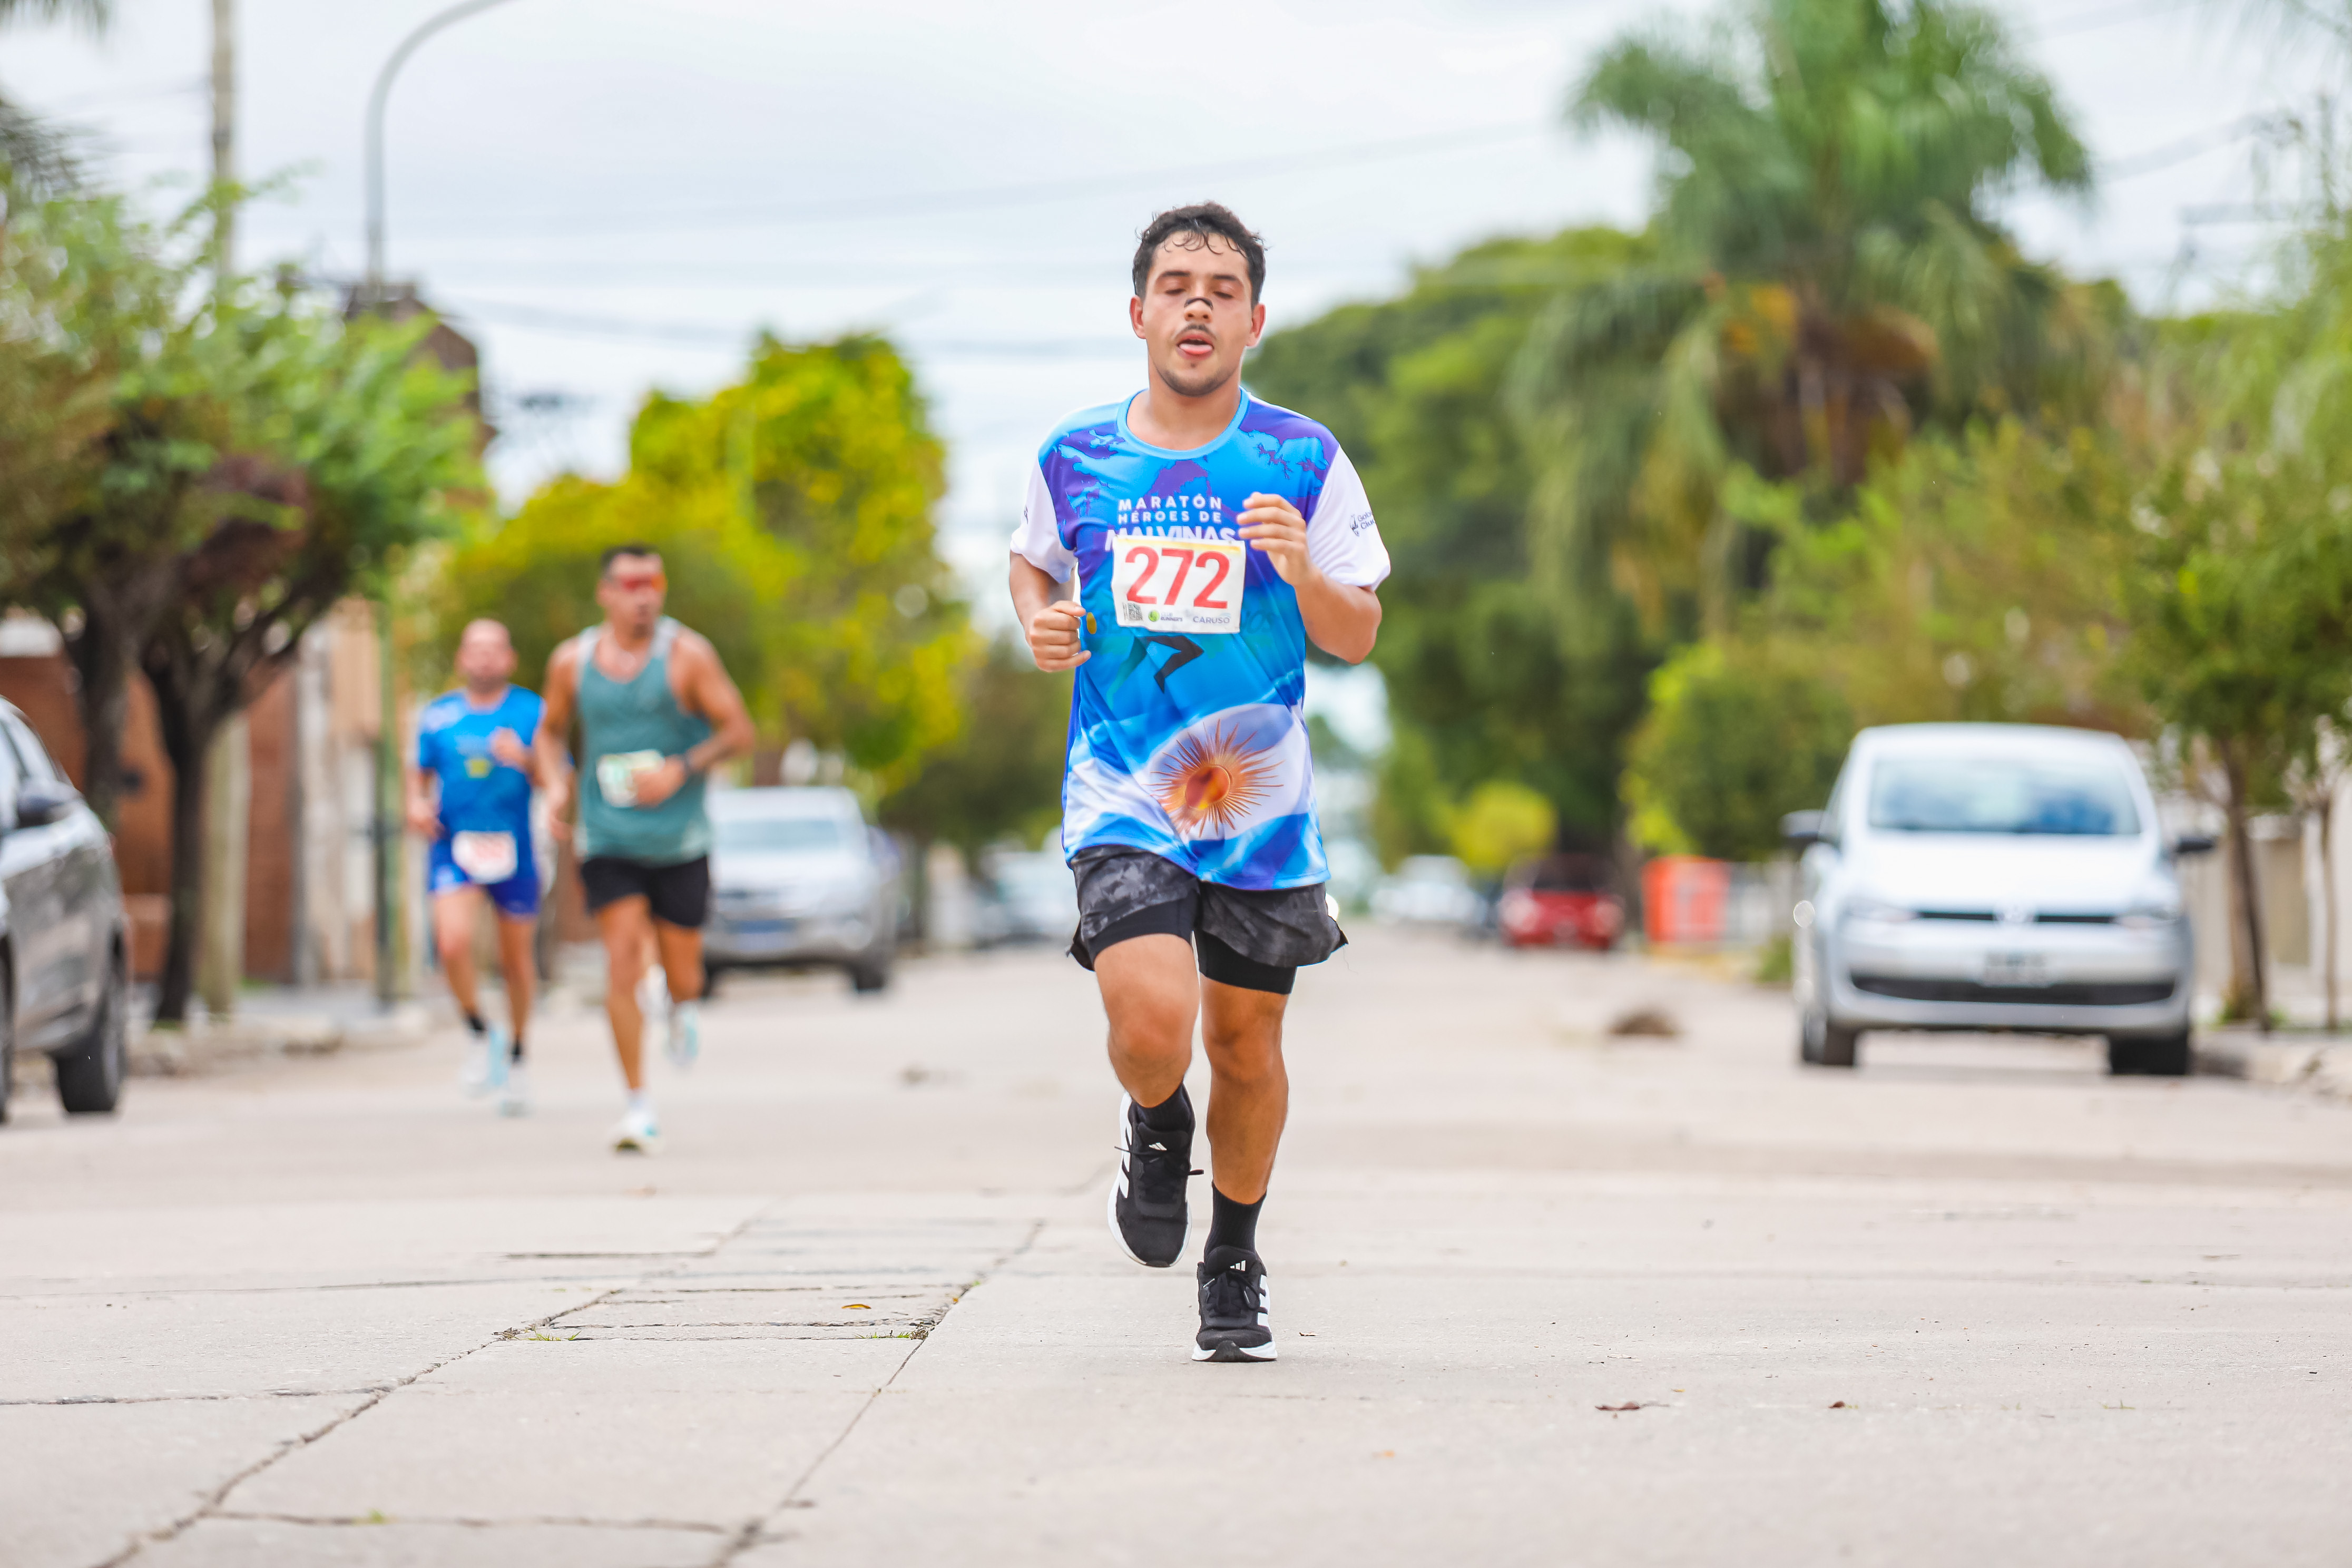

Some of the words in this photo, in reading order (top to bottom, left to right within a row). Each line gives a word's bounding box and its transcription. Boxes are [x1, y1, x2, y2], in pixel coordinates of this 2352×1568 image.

[1118, 494, 1222, 511] MARATÓN
[1118, 510, 1190, 524] HÉROES
[1199, 511, 1221, 523] DE
[1125, 546, 1230, 609] 272
